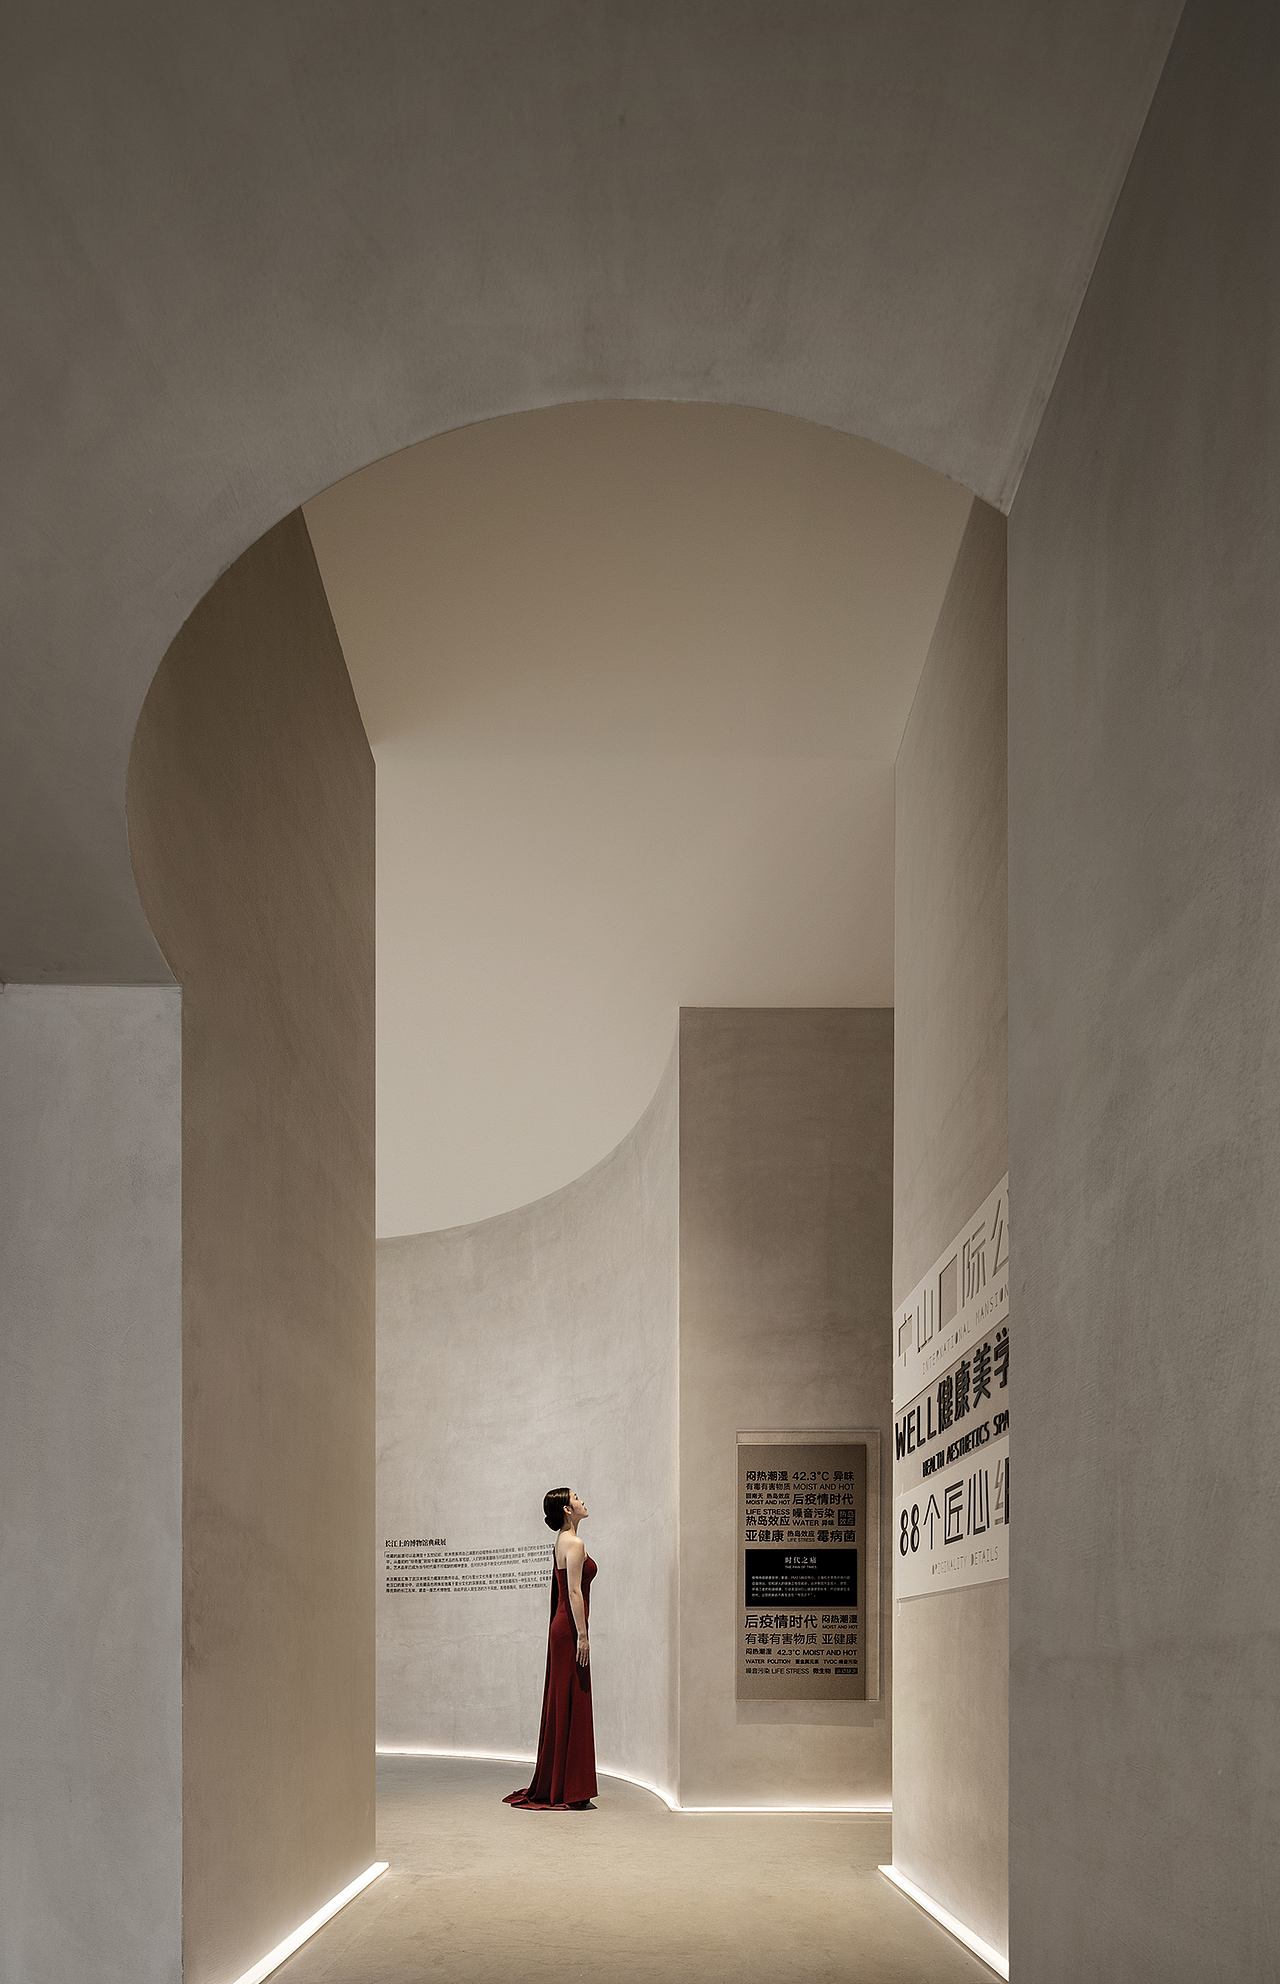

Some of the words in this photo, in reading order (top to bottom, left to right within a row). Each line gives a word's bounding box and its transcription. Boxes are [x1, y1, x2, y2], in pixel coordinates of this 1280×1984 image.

[922, 1449, 944, 1477] HEALTH
[946, 1421, 990, 1464] AESTHETICS
[746, 1471, 788, 1481] 闷热潮湿
[833, 1471, 854, 1481] 异味
[792, 1494, 853, 1505] 后疫情时代
[793, 1508, 834, 1518] 噪音污染
[746, 1516, 790, 1526] 热岛效应
[746, 1530, 784, 1542] 亚健康
[817, 1530, 856, 1542] 霉病菌
[971, 1546, 998, 1566] DETAILS
[745, 1614, 817, 1628] 后疫情时代
[822, 1615, 857, 1623] 闷热潮湿
[746, 1633, 817, 1644] 有毒有害物质
[822, 1633, 857, 1644] 亚健康
